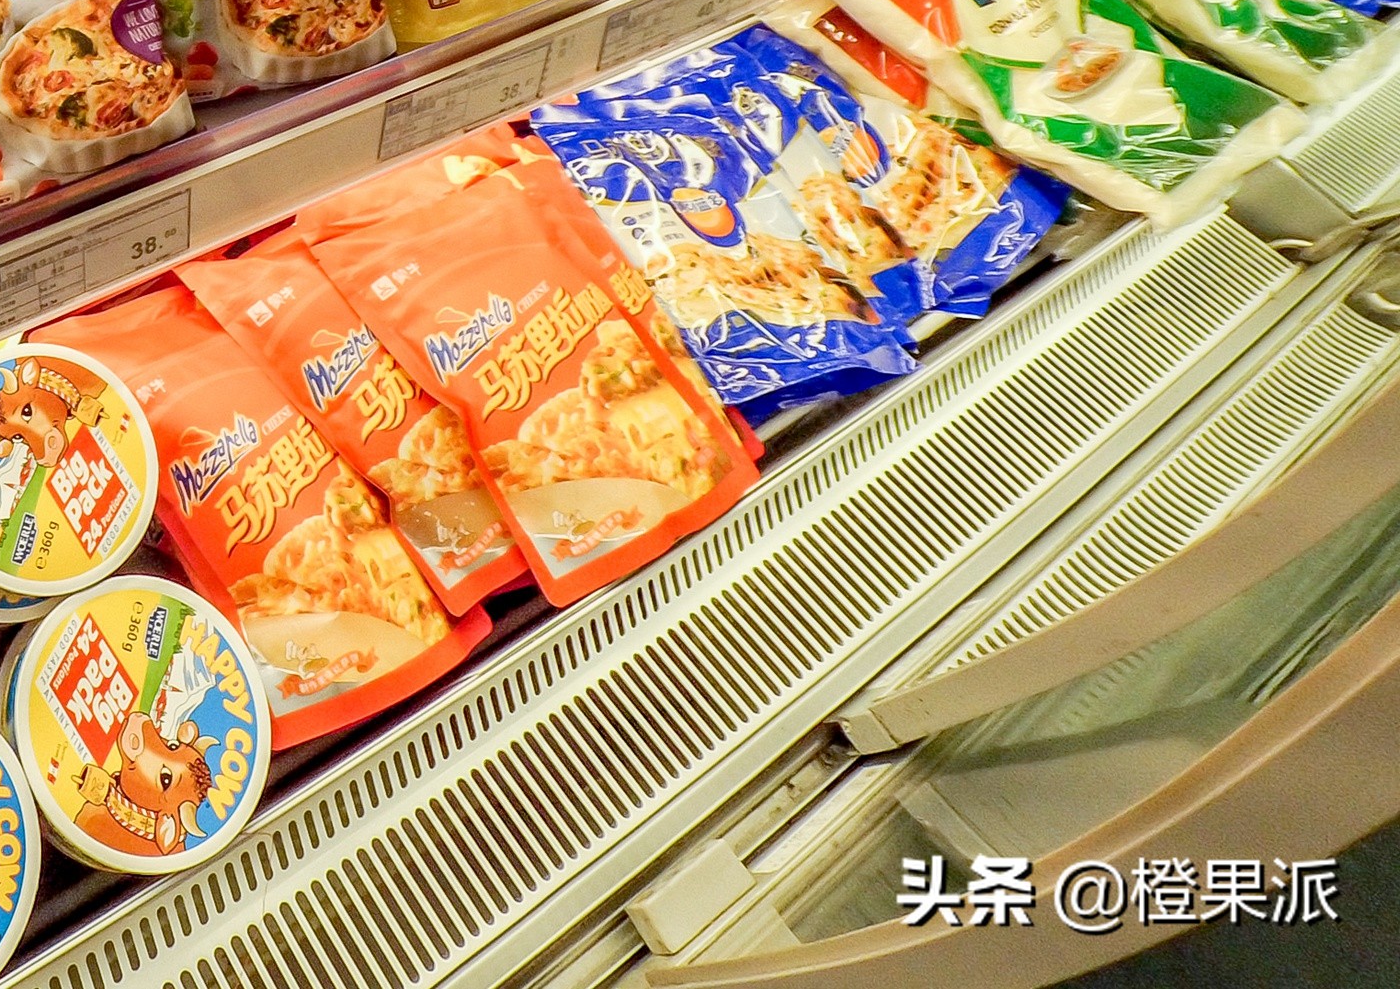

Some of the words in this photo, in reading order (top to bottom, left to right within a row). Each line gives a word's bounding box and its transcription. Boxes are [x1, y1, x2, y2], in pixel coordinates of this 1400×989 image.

[426, 297, 514, 384] Mozzarella
[93, 428, 110, 454] TIME
[109, 455, 125, 476] ANY
[170, 417, 258, 517] Mozzarella
[50, 450, 91, 505] Big
[63, 458, 114, 532] Pack
[81, 520, 104, 553] 24
[100, 488, 126, 529] Portions
[118, 491, 139, 523] TASTE
[12, 515, 35, 564] WOERLE
[101, 522, 121, 553] GOOD
[76, 618, 99, 656] 24
[148, 606, 167, 660] WOERLE
[52, 648, 77, 689] Portions
[66, 638, 119, 725] Pack
[179, 615, 255, 724] HAPPY
[93, 673, 134, 735] Big
[207, 727, 253, 821] COW
